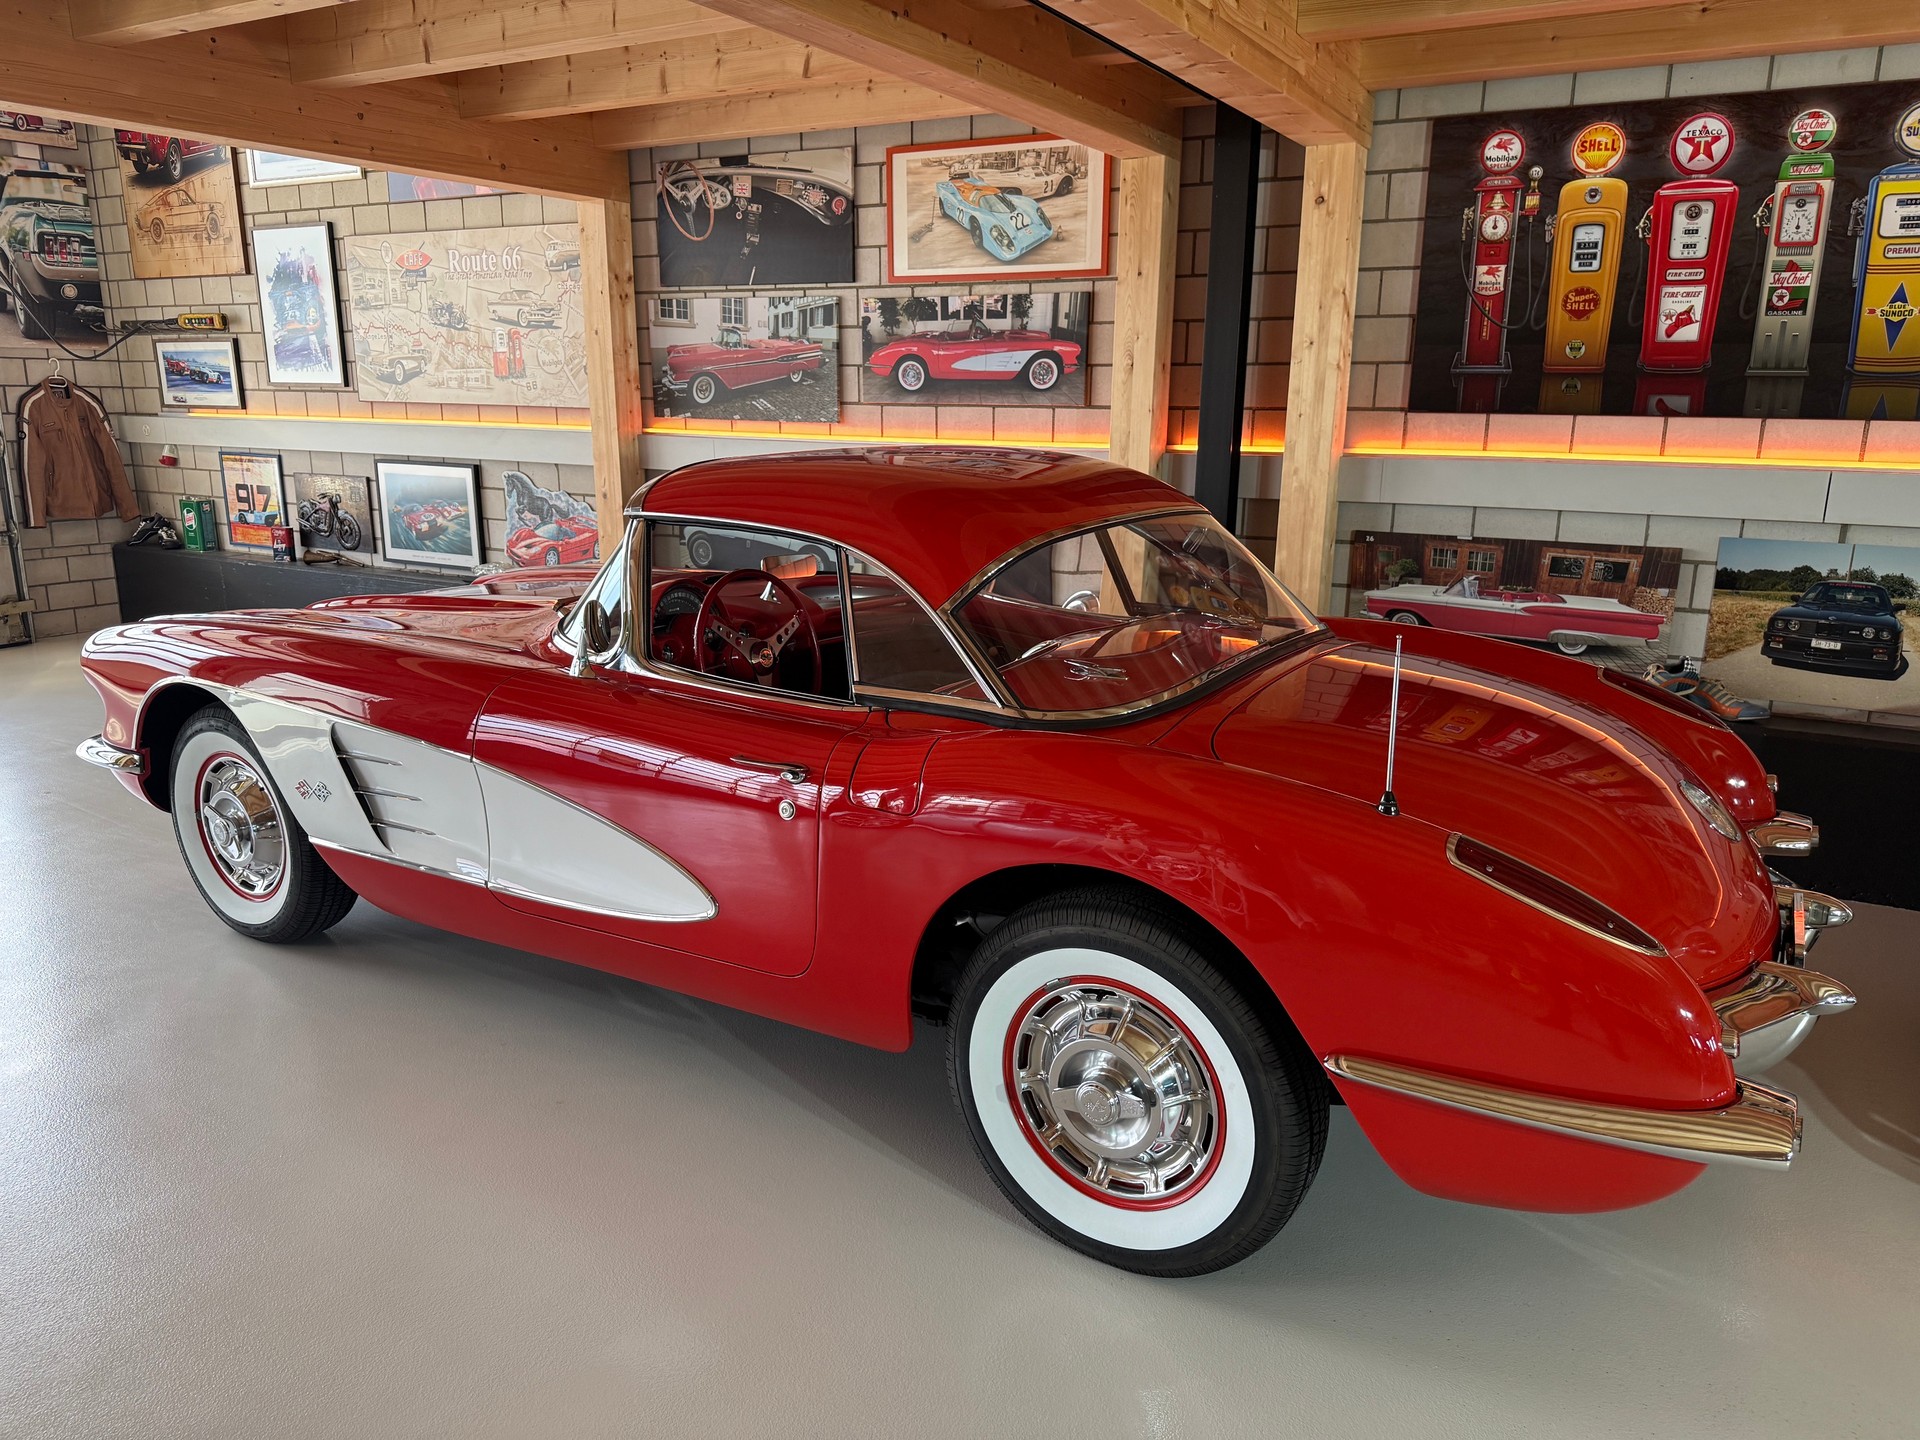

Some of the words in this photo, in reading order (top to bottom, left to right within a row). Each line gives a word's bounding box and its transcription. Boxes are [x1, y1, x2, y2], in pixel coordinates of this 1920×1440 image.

[1795, 120, 1810, 131] Sky
[1810, 118, 1830, 129] Chief
[1686, 129, 1723, 137] TEXACO
[1579, 138, 1617, 153] SHELL
[1485, 154, 1518, 163] Mobilgas
[1043, 179, 1053, 193] 21
[956, 206, 965, 226] 22
[1009, 212, 1029, 231] 22
[447, 248, 497, 273] Route
[502, 246, 522, 270] 66
[444, 271, 454, 280] The
[455, 271, 472, 280] Great
[473, 270, 502, 280] American
[519, 268, 533, 280] Trip
[1769, 272, 1787, 287] Sky
[1786, 272, 1812, 285] Chief
[1663, 290, 1703, 298] FIRE-CHIEF
[1566, 302, 1595, 310] SHELL
[1879, 309, 1915, 318] SUNOCO
[235, 483, 272, 513] 917
